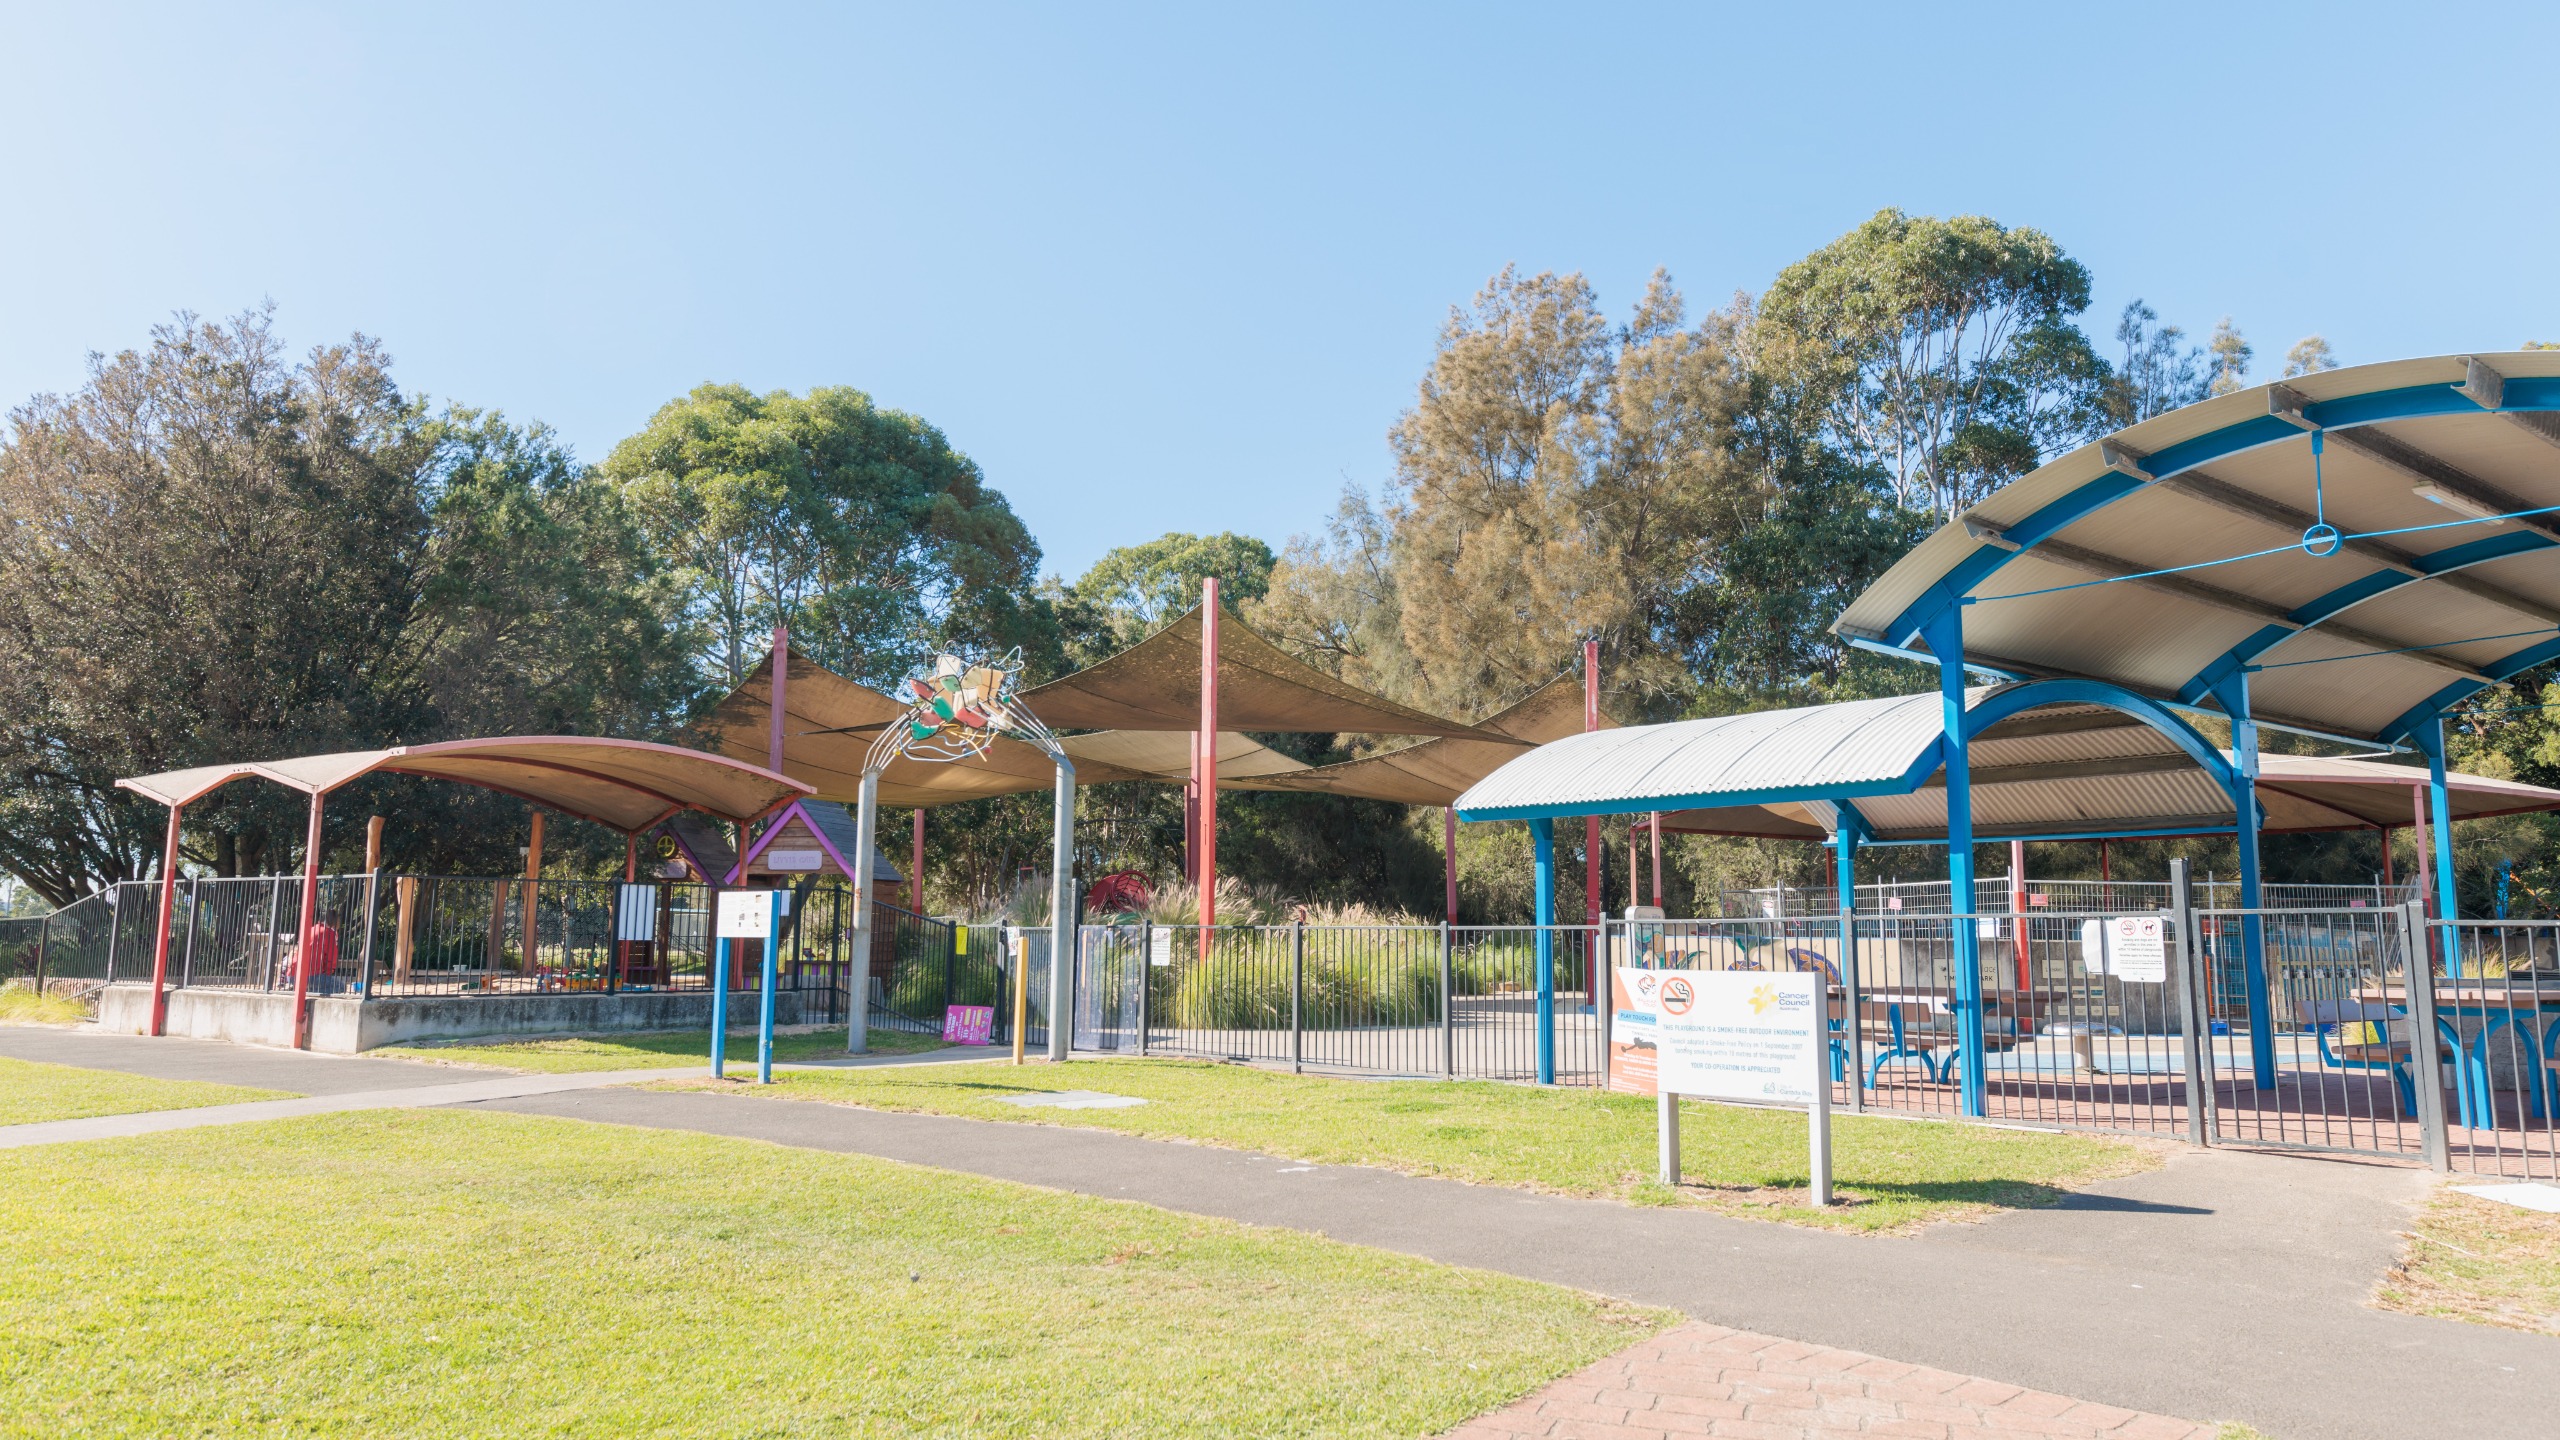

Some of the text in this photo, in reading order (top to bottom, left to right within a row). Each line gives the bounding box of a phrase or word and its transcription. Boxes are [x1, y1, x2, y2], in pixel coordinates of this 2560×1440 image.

[1779, 998, 1810, 1006] Council
[1663, 1023, 1673, 1031] THIS
[1675, 1024, 1705, 1032] PLAYGROUND
[1749, 1027, 1771, 1035] OUTDOOR
[1774, 1028, 1809, 1036] ENVIRONMENT
[1747, 1065, 1781, 1074] APPRECIATED
